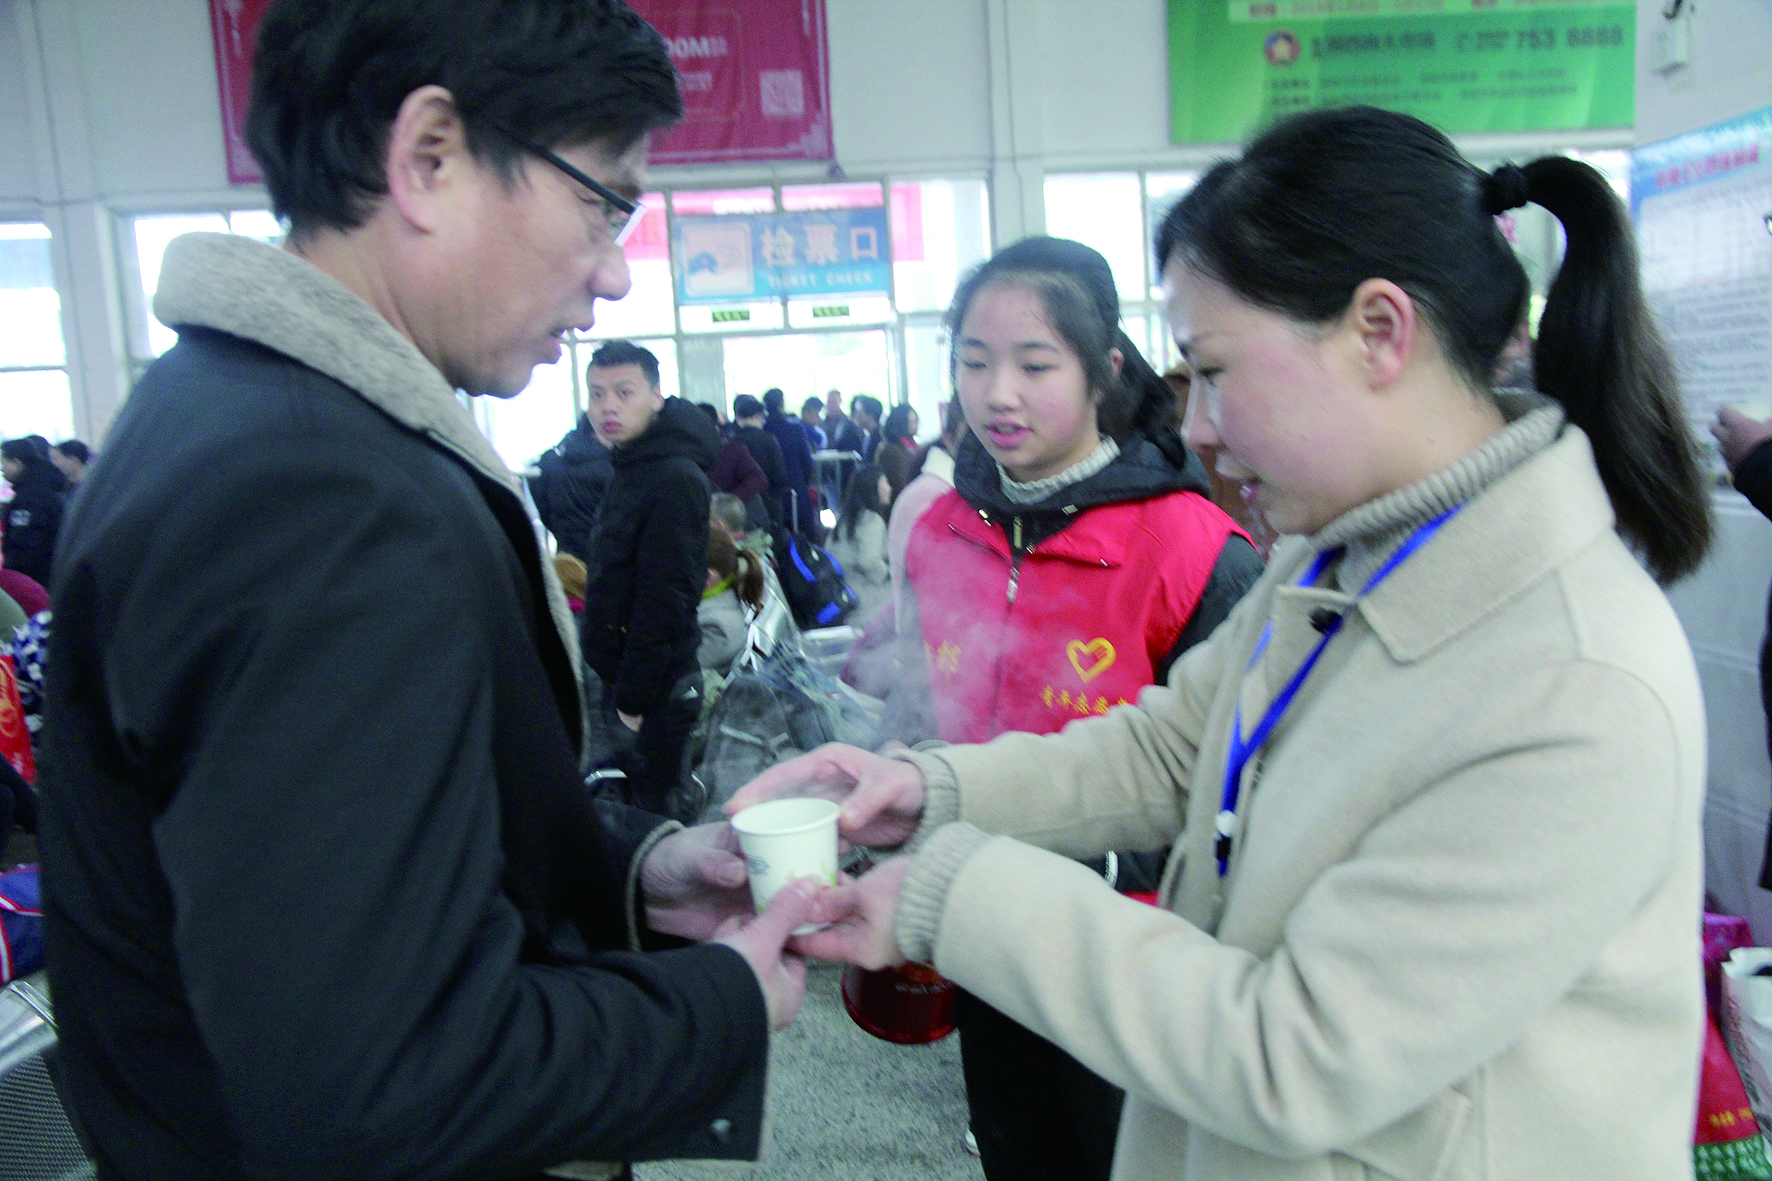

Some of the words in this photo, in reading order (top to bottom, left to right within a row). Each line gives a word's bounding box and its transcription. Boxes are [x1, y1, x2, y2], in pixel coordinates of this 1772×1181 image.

[760, 224, 878, 267] 检票口
[767, 272, 817, 288] TICKET
[825, 270, 873, 286] CHECK
